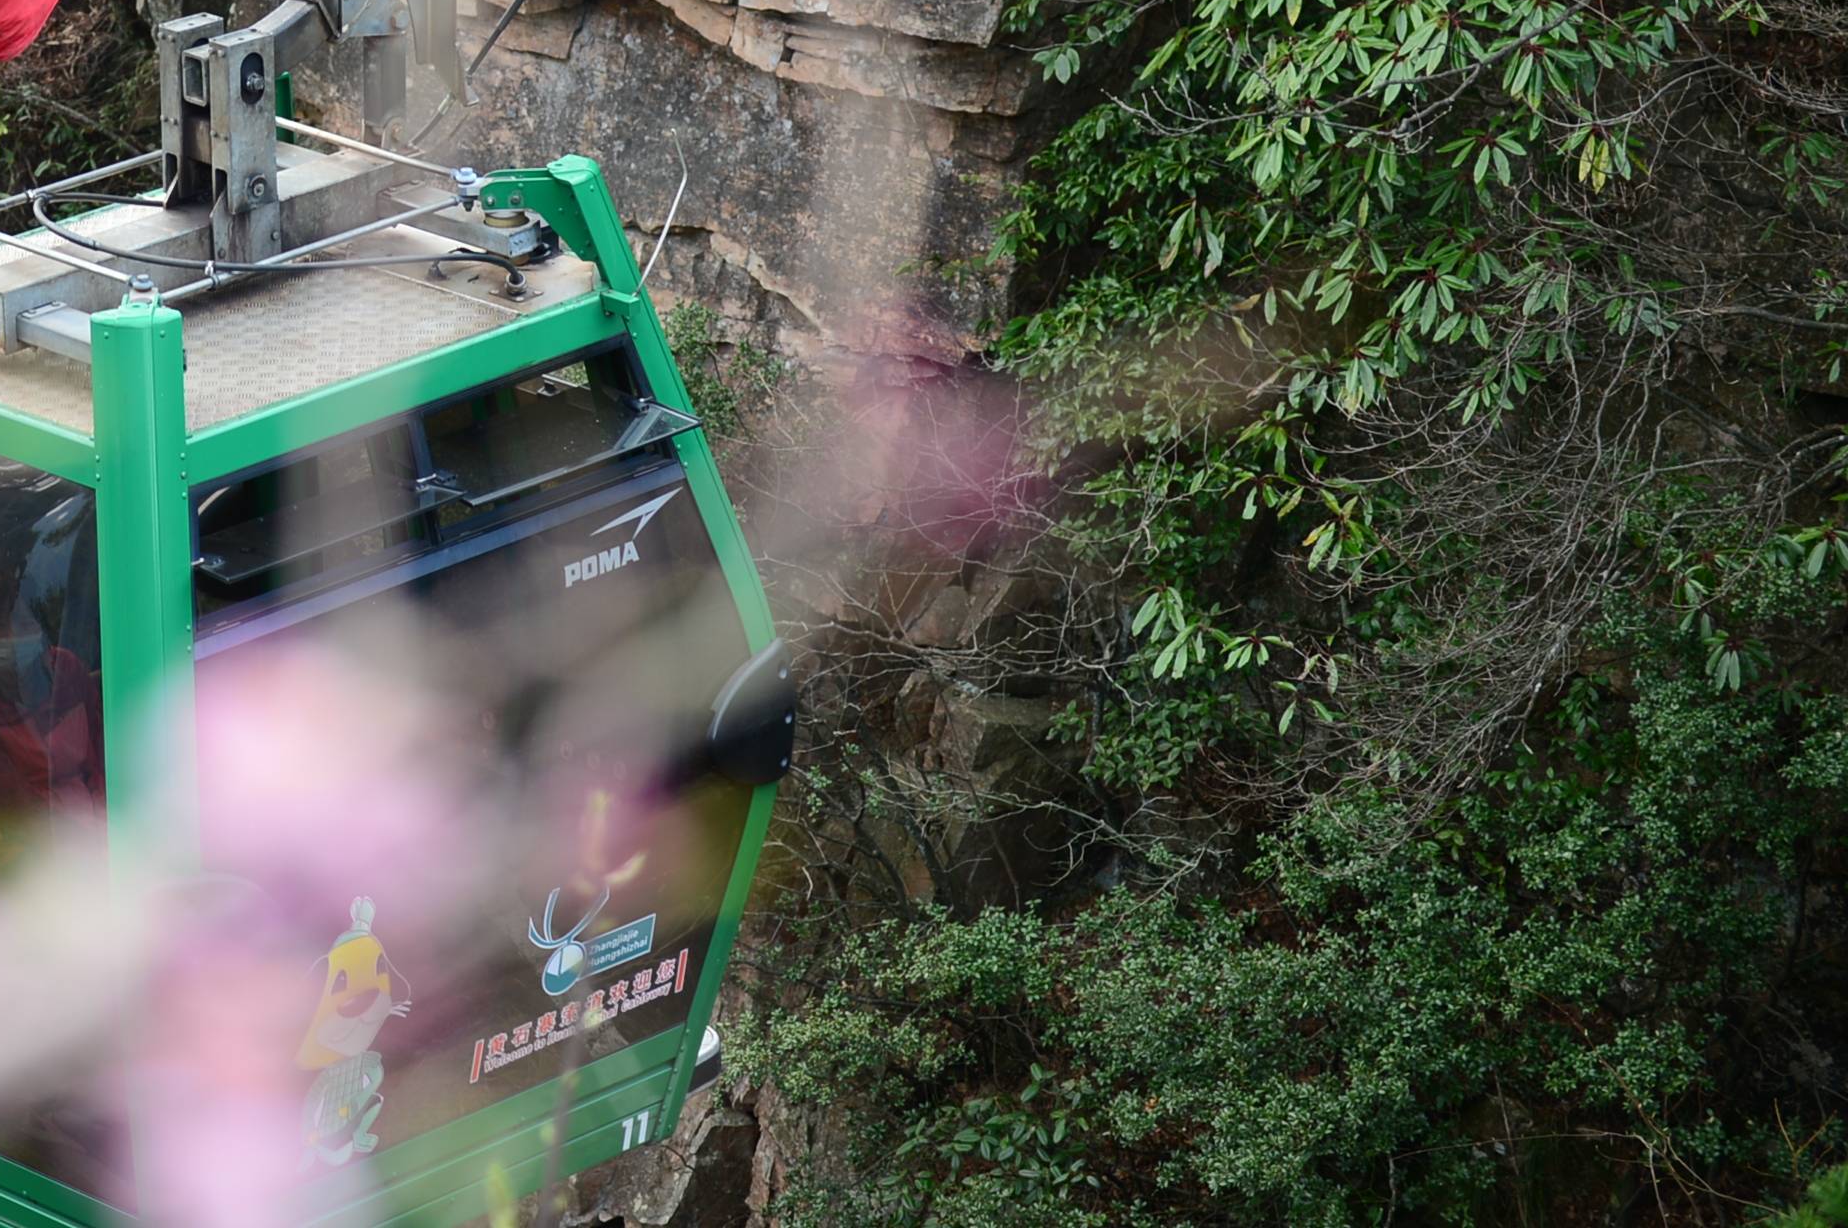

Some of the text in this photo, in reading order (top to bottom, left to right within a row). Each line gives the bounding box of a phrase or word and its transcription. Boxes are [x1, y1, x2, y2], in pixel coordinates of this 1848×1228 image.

[564, 540, 640, 588] POMA
[588, 929, 639, 954] Zhangjiajie
[483, 1043, 533, 1073] Welcome
[533, 1037, 547, 1051] to
[621, 982, 672, 1012] Cableway
[622, 1111, 649, 1151] 11
